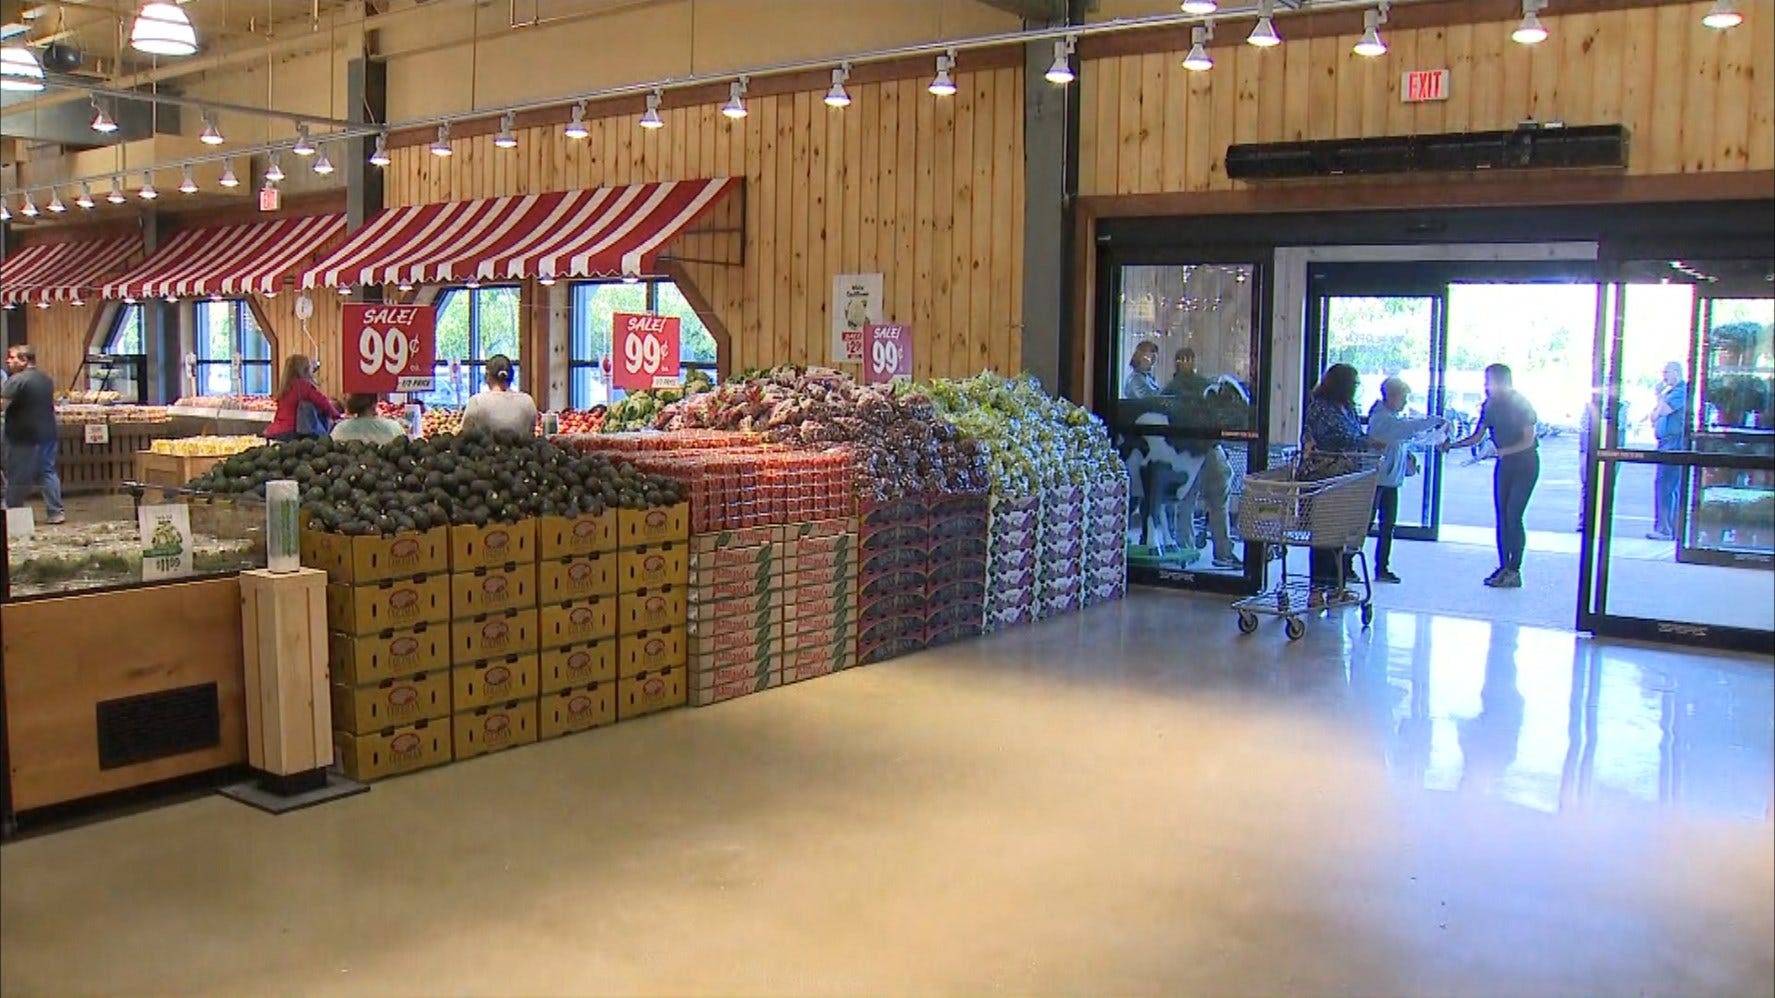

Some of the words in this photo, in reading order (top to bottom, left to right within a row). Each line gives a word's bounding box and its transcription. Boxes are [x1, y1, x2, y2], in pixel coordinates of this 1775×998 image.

[1408, 71, 1442, 98] EXIT
[363, 308, 418, 326] SALE!
[627, 317, 667, 333] SALE!
[873, 327, 901, 339] SALE!
